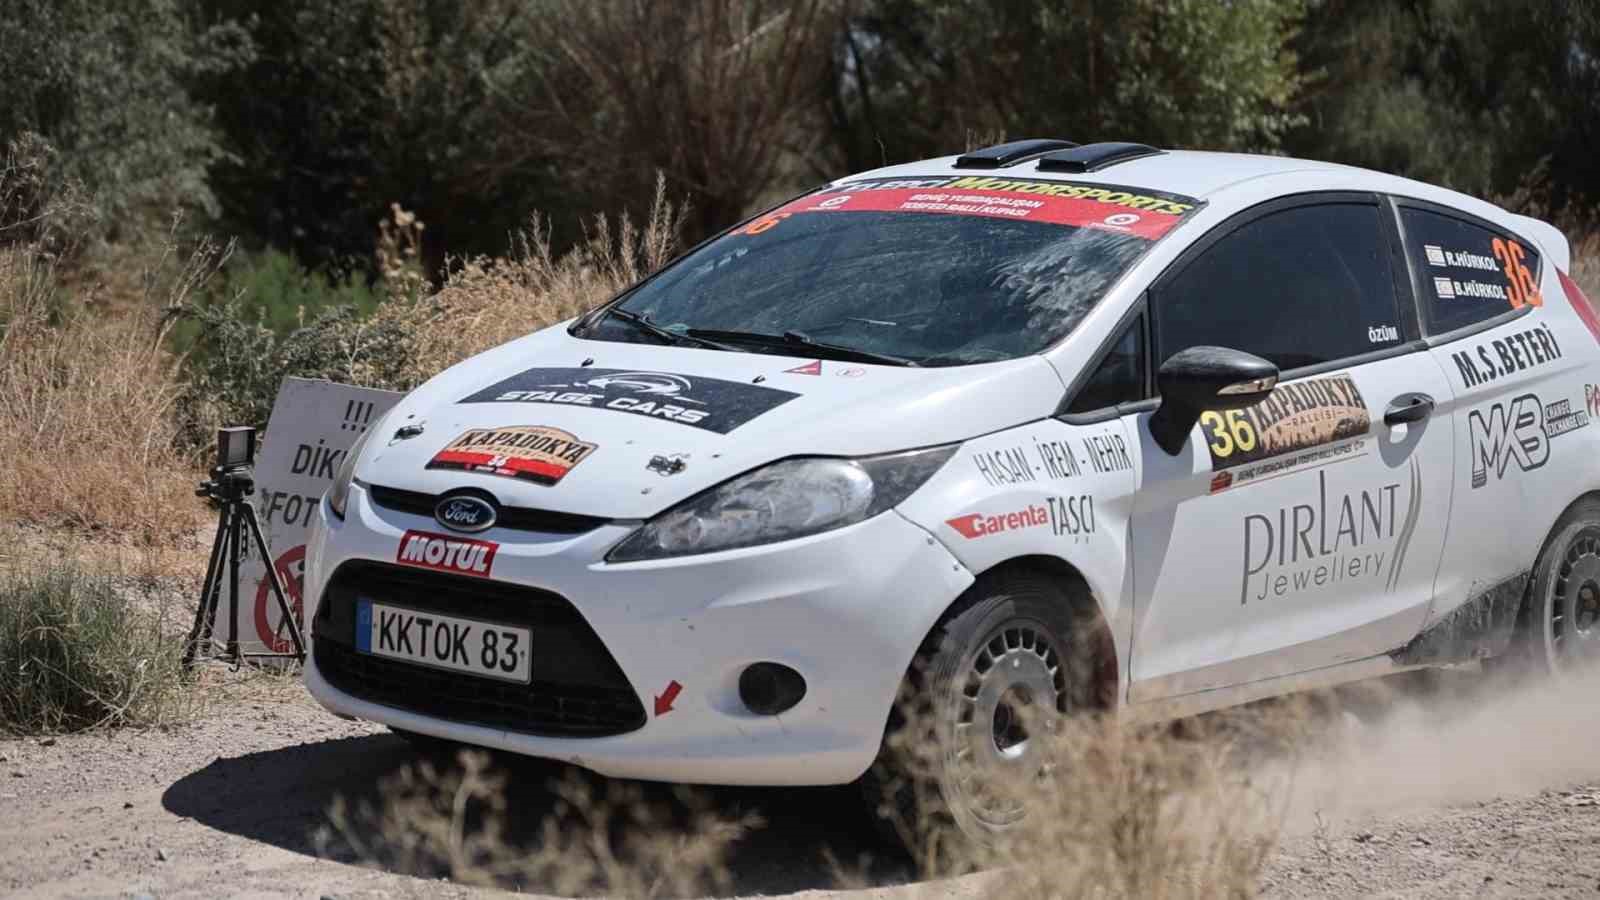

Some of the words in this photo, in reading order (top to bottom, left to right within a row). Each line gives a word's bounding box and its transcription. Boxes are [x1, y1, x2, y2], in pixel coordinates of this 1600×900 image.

[1445, 251, 1500, 271] R.HÜRKOL
[1492, 238, 1543, 309] 36
[1453, 280, 1507, 300] B.HÜRKOL
[1368, 326, 1398, 342] ÖZÜM
[1452, 322, 1562, 388] M.S.BETERİ
[496, 391, 604, 405] STAGE
[606, 398, 710, 423] CARS
[1251, 378, 1368, 432] KAPADOKYA
[456, 431, 588, 463] KAPADOKYA
[1201, 410, 1256, 457] 36
[973, 447, 1036, 487] HASAN
[1032, 436, 1081, 479] İREM
[1083, 429, 1132, 473] NEHİR
[444, 502, 478, 524] Ford
[970, 504, 1048, 537] Garenta
[1046, 495, 1096, 544] TAŞÇI
[401, 535, 489, 573] MOTUL
[1241, 470, 1400, 606] PIRLANT
[481, 629, 519, 673] 83
